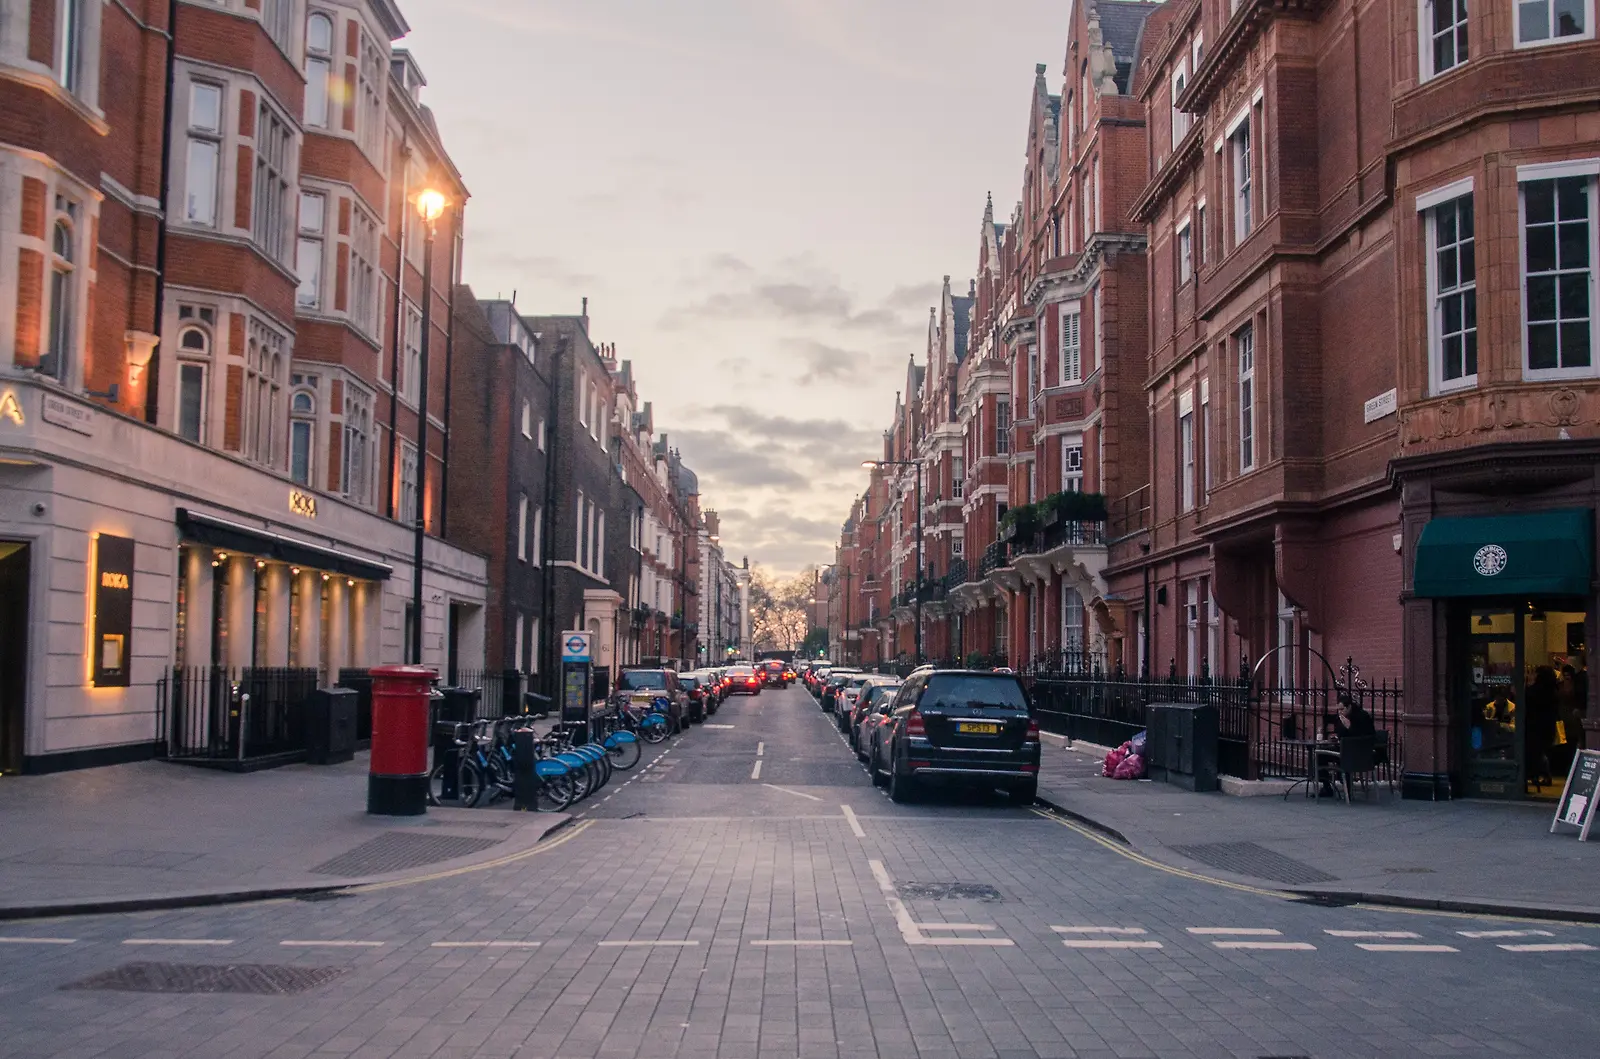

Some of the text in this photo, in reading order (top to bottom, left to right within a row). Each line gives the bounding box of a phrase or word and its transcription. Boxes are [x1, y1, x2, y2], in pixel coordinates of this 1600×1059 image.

[0, 388, 25, 426] A
[1475, 546, 1506, 560] STARBUCKS
[1478, 566, 1500, 574] COFFEE
[101, 571, 129, 589] ROKA
